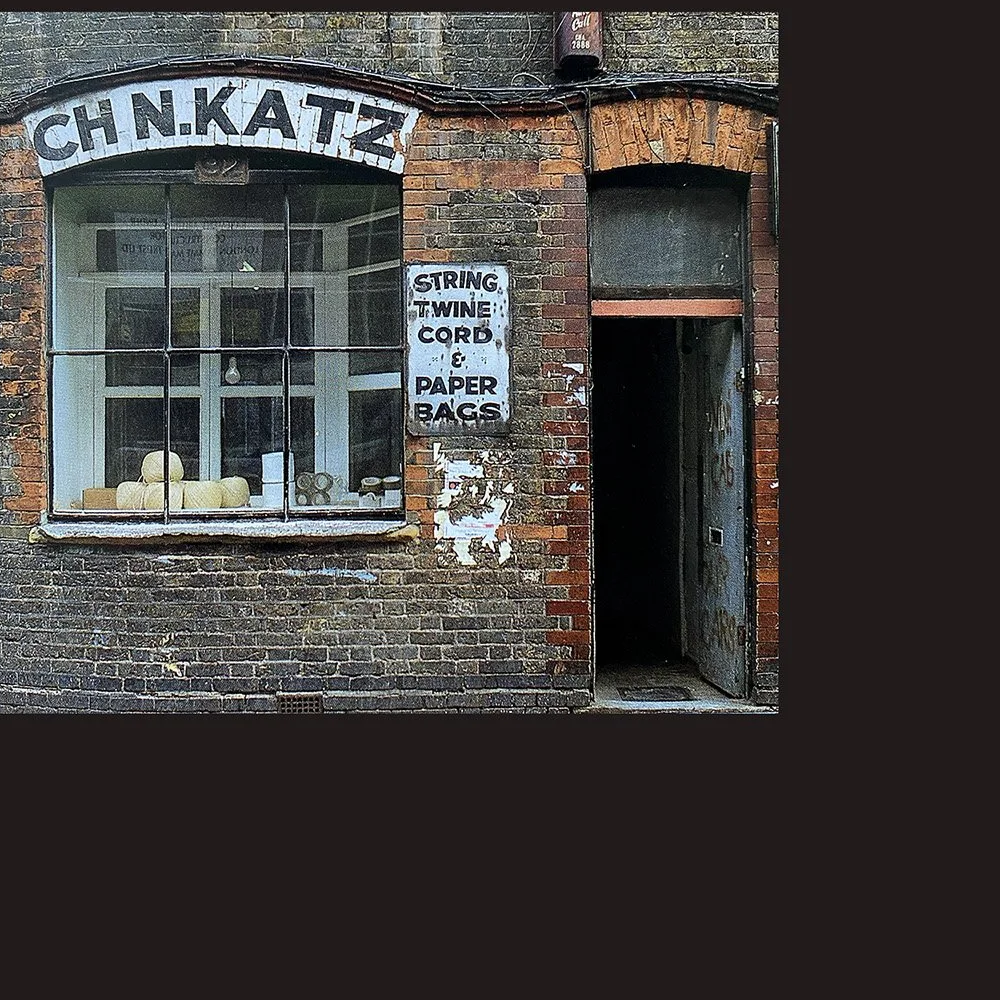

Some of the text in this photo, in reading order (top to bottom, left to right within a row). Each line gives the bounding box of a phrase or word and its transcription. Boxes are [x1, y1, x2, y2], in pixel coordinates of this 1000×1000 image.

[34, 98, 118, 161] CH
[413, 270, 499, 293] STRING
[413, 301, 492, 318] TWINE
[417, 326, 493, 344] CORD
[451, 351, 466, 369] &
[415, 376, 498, 396] PAPER
[413, 402, 502, 422] BAGS
